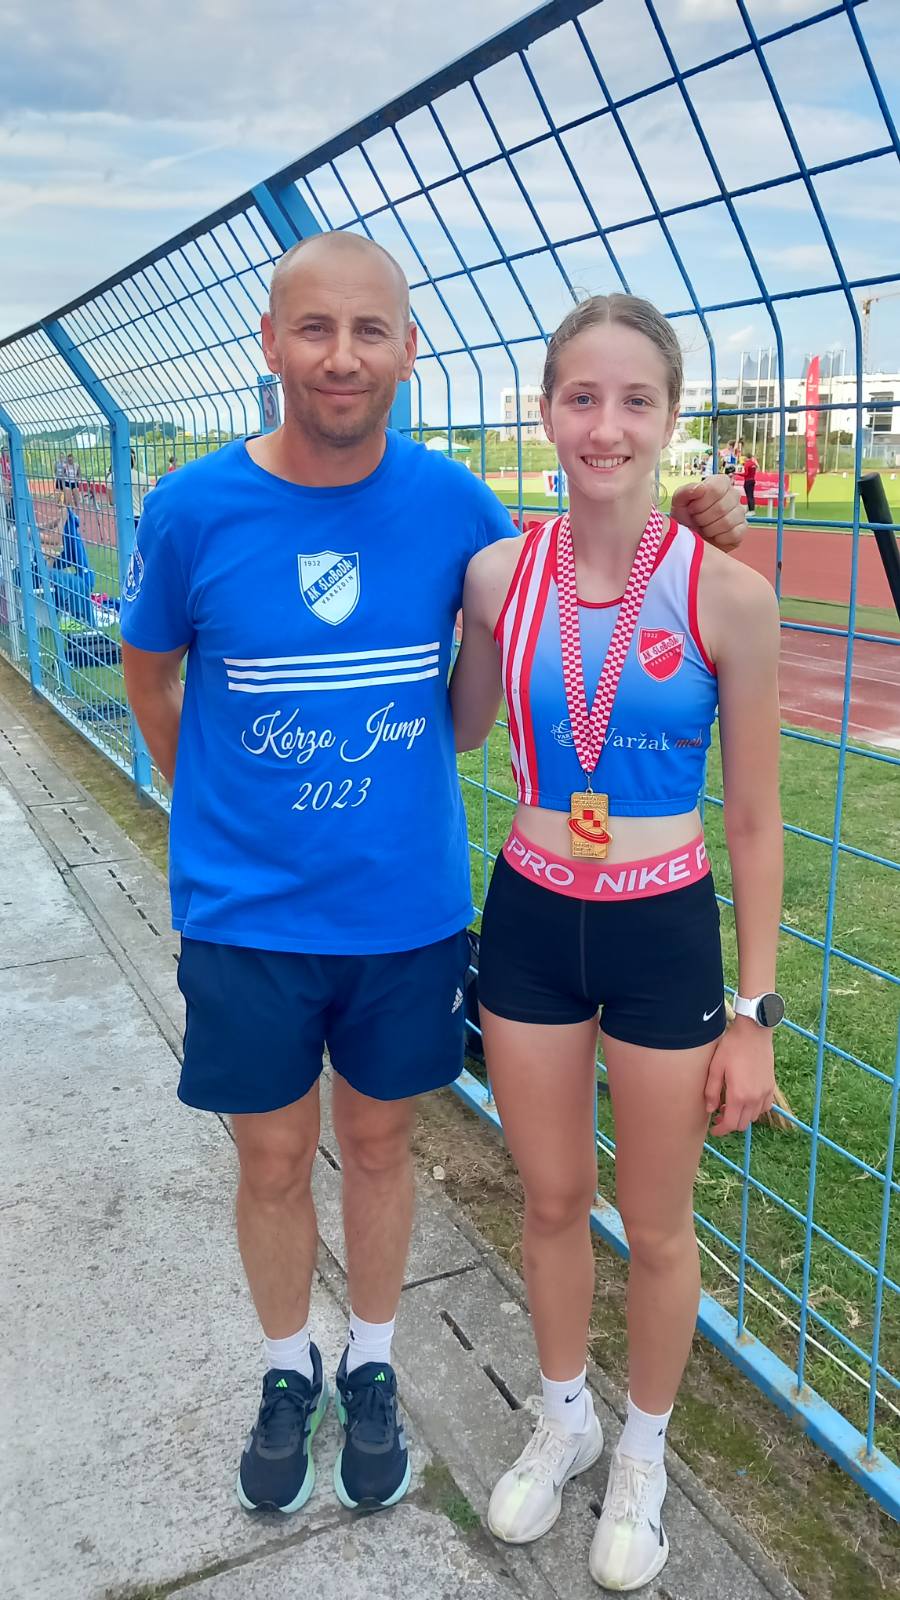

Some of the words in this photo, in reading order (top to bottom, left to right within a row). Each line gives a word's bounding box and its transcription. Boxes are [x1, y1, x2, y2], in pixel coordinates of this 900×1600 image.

[306, 585, 322, 602] AK
[643, 649, 653, 661] AK
[241, 708, 337, 765] Korzo
[340, 702, 426, 763] Jump
[603, 727, 670, 751] Varžak
[291, 777, 372, 811] 2023
[506, 838, 575, 886] PRO
[594, 853, 691, 893] NIKE
